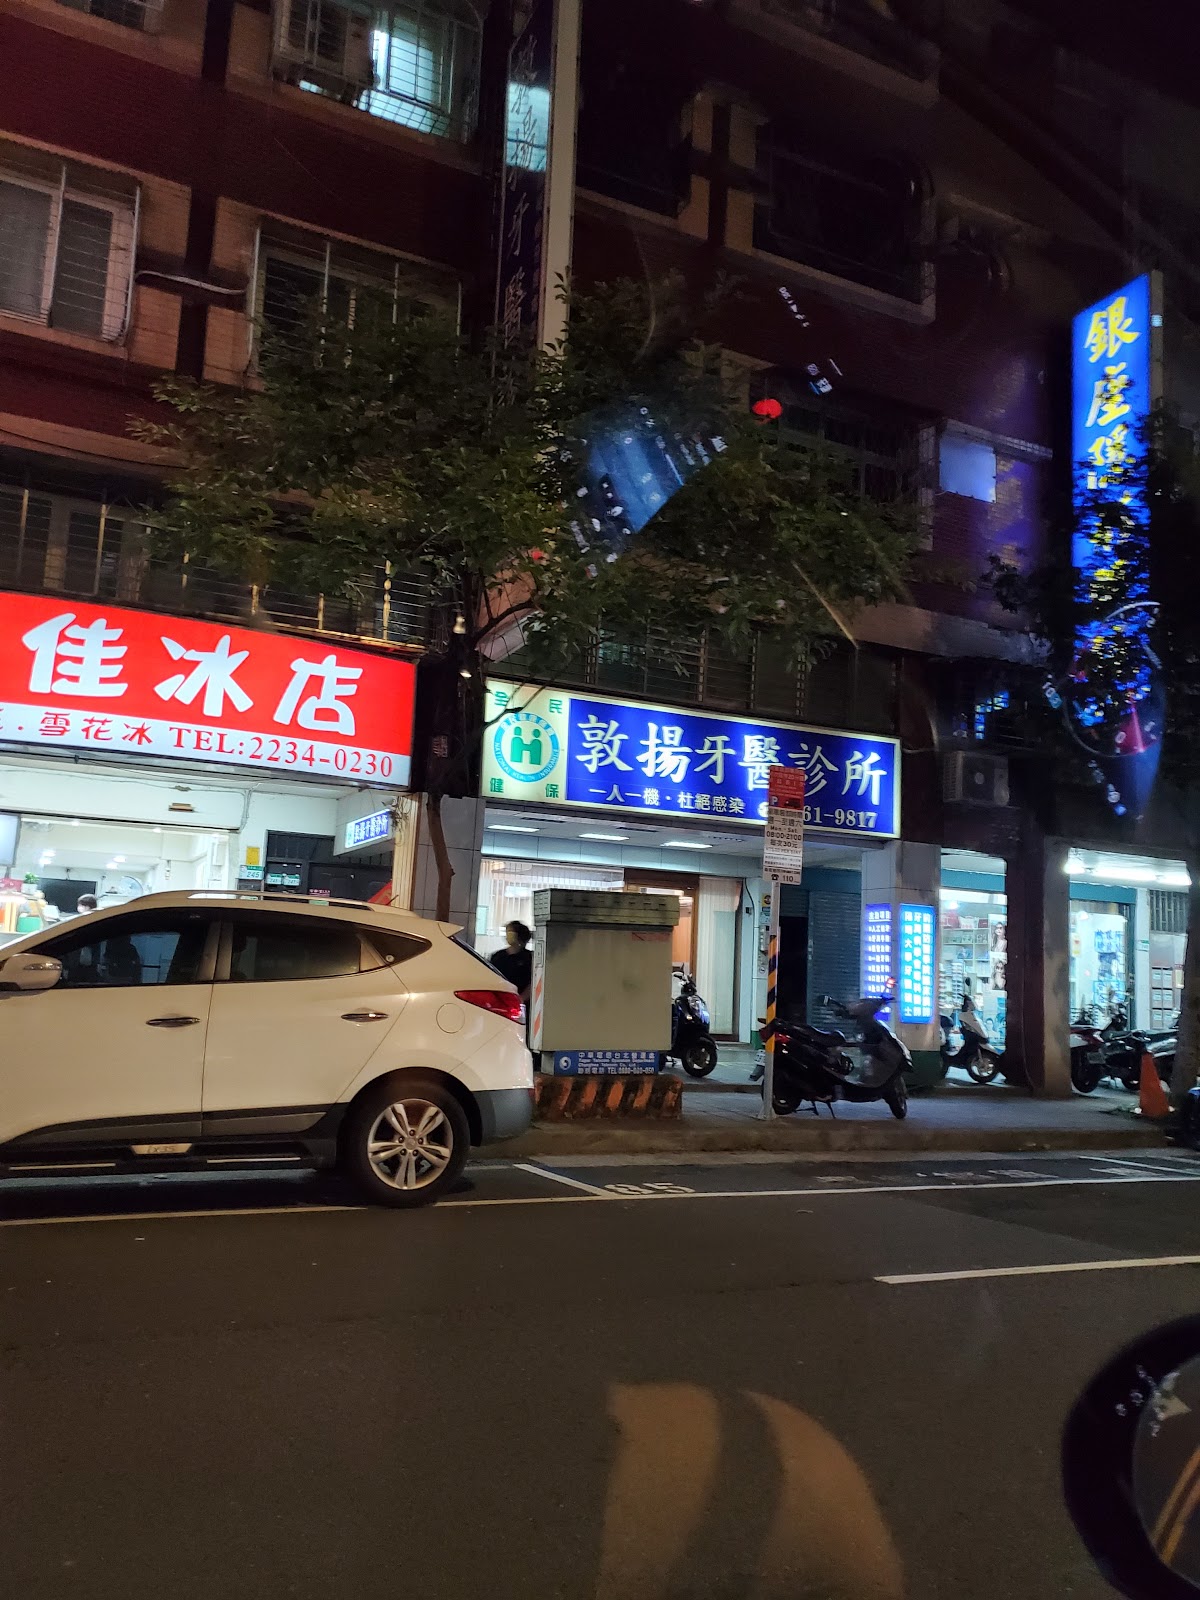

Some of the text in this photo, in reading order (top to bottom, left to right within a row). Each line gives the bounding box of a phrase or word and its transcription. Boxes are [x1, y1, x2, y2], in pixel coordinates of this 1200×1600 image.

[21, 612, 364, 737] 佳冰店
[168, 726, 394, 778] TEL:2234-0230
[575, 714, 889, 807] 敦揚牙醫診所
[802, 803, 878, 829] 61-9817
